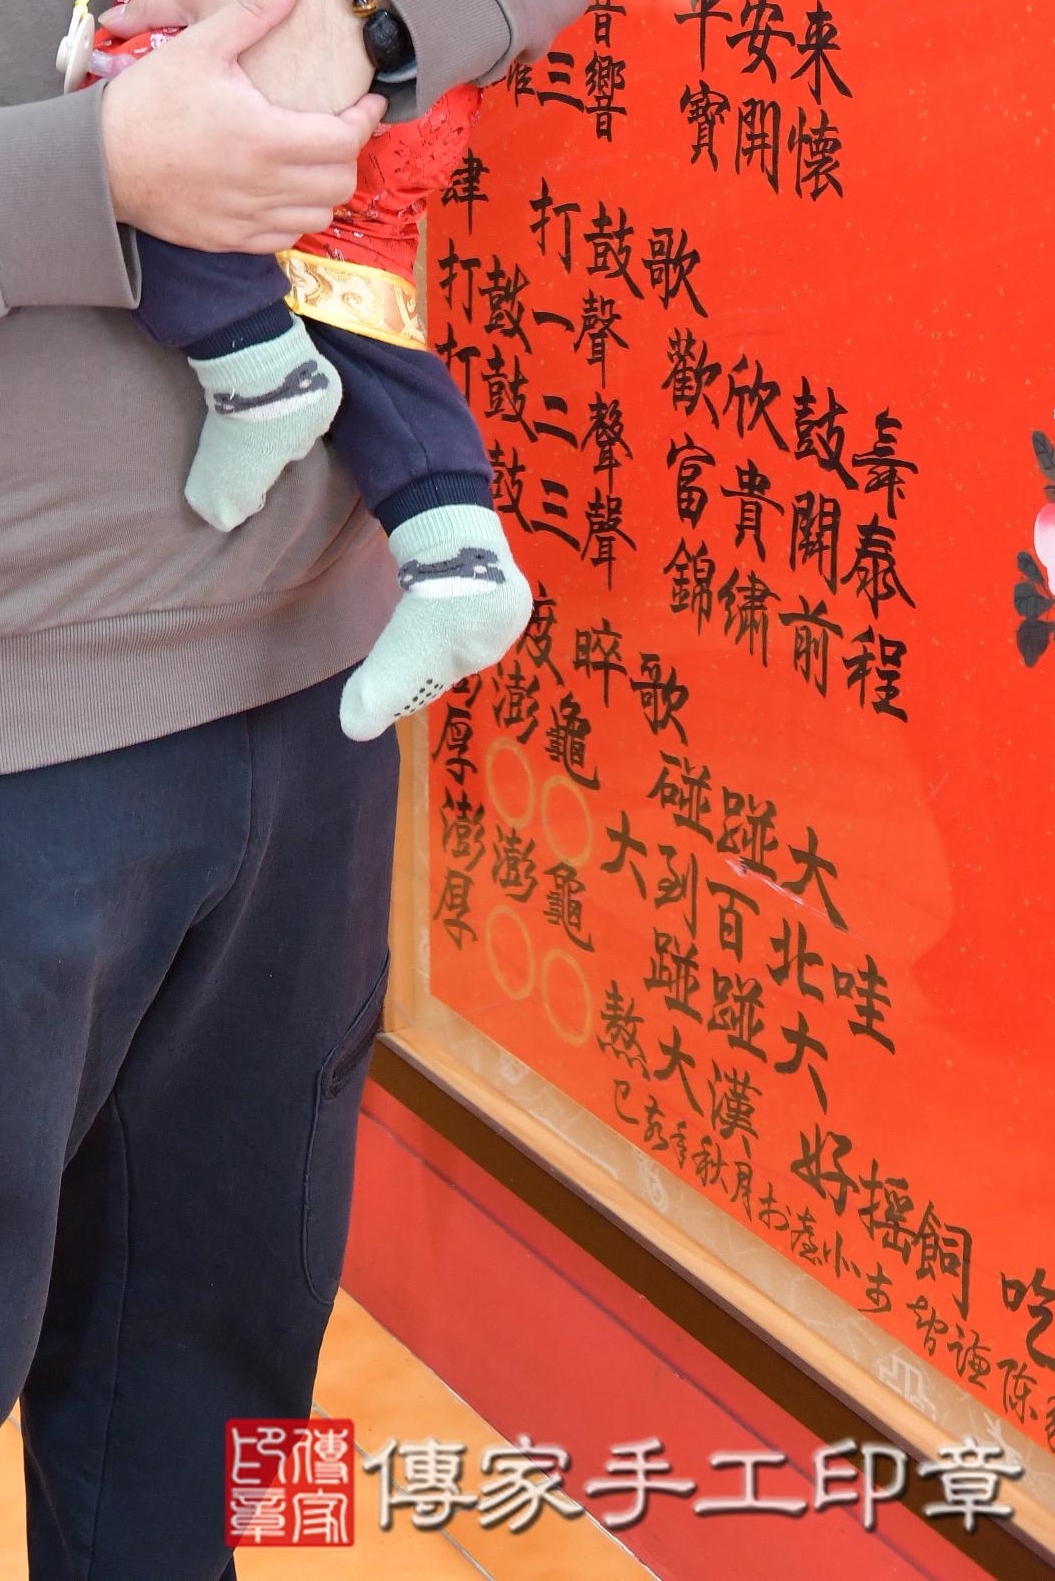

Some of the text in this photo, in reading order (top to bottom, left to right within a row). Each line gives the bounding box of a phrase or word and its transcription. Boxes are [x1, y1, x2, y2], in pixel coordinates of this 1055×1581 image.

[679, 79, 845, 202] 寶開懷
[436, 236, 631, 388] 打鼓一聲
[529, 177, 709, 319] 打鼓歌
[488, 440, 637, 591] 鼓三聲
[665, 432, 917, 619] 富貴開泰
